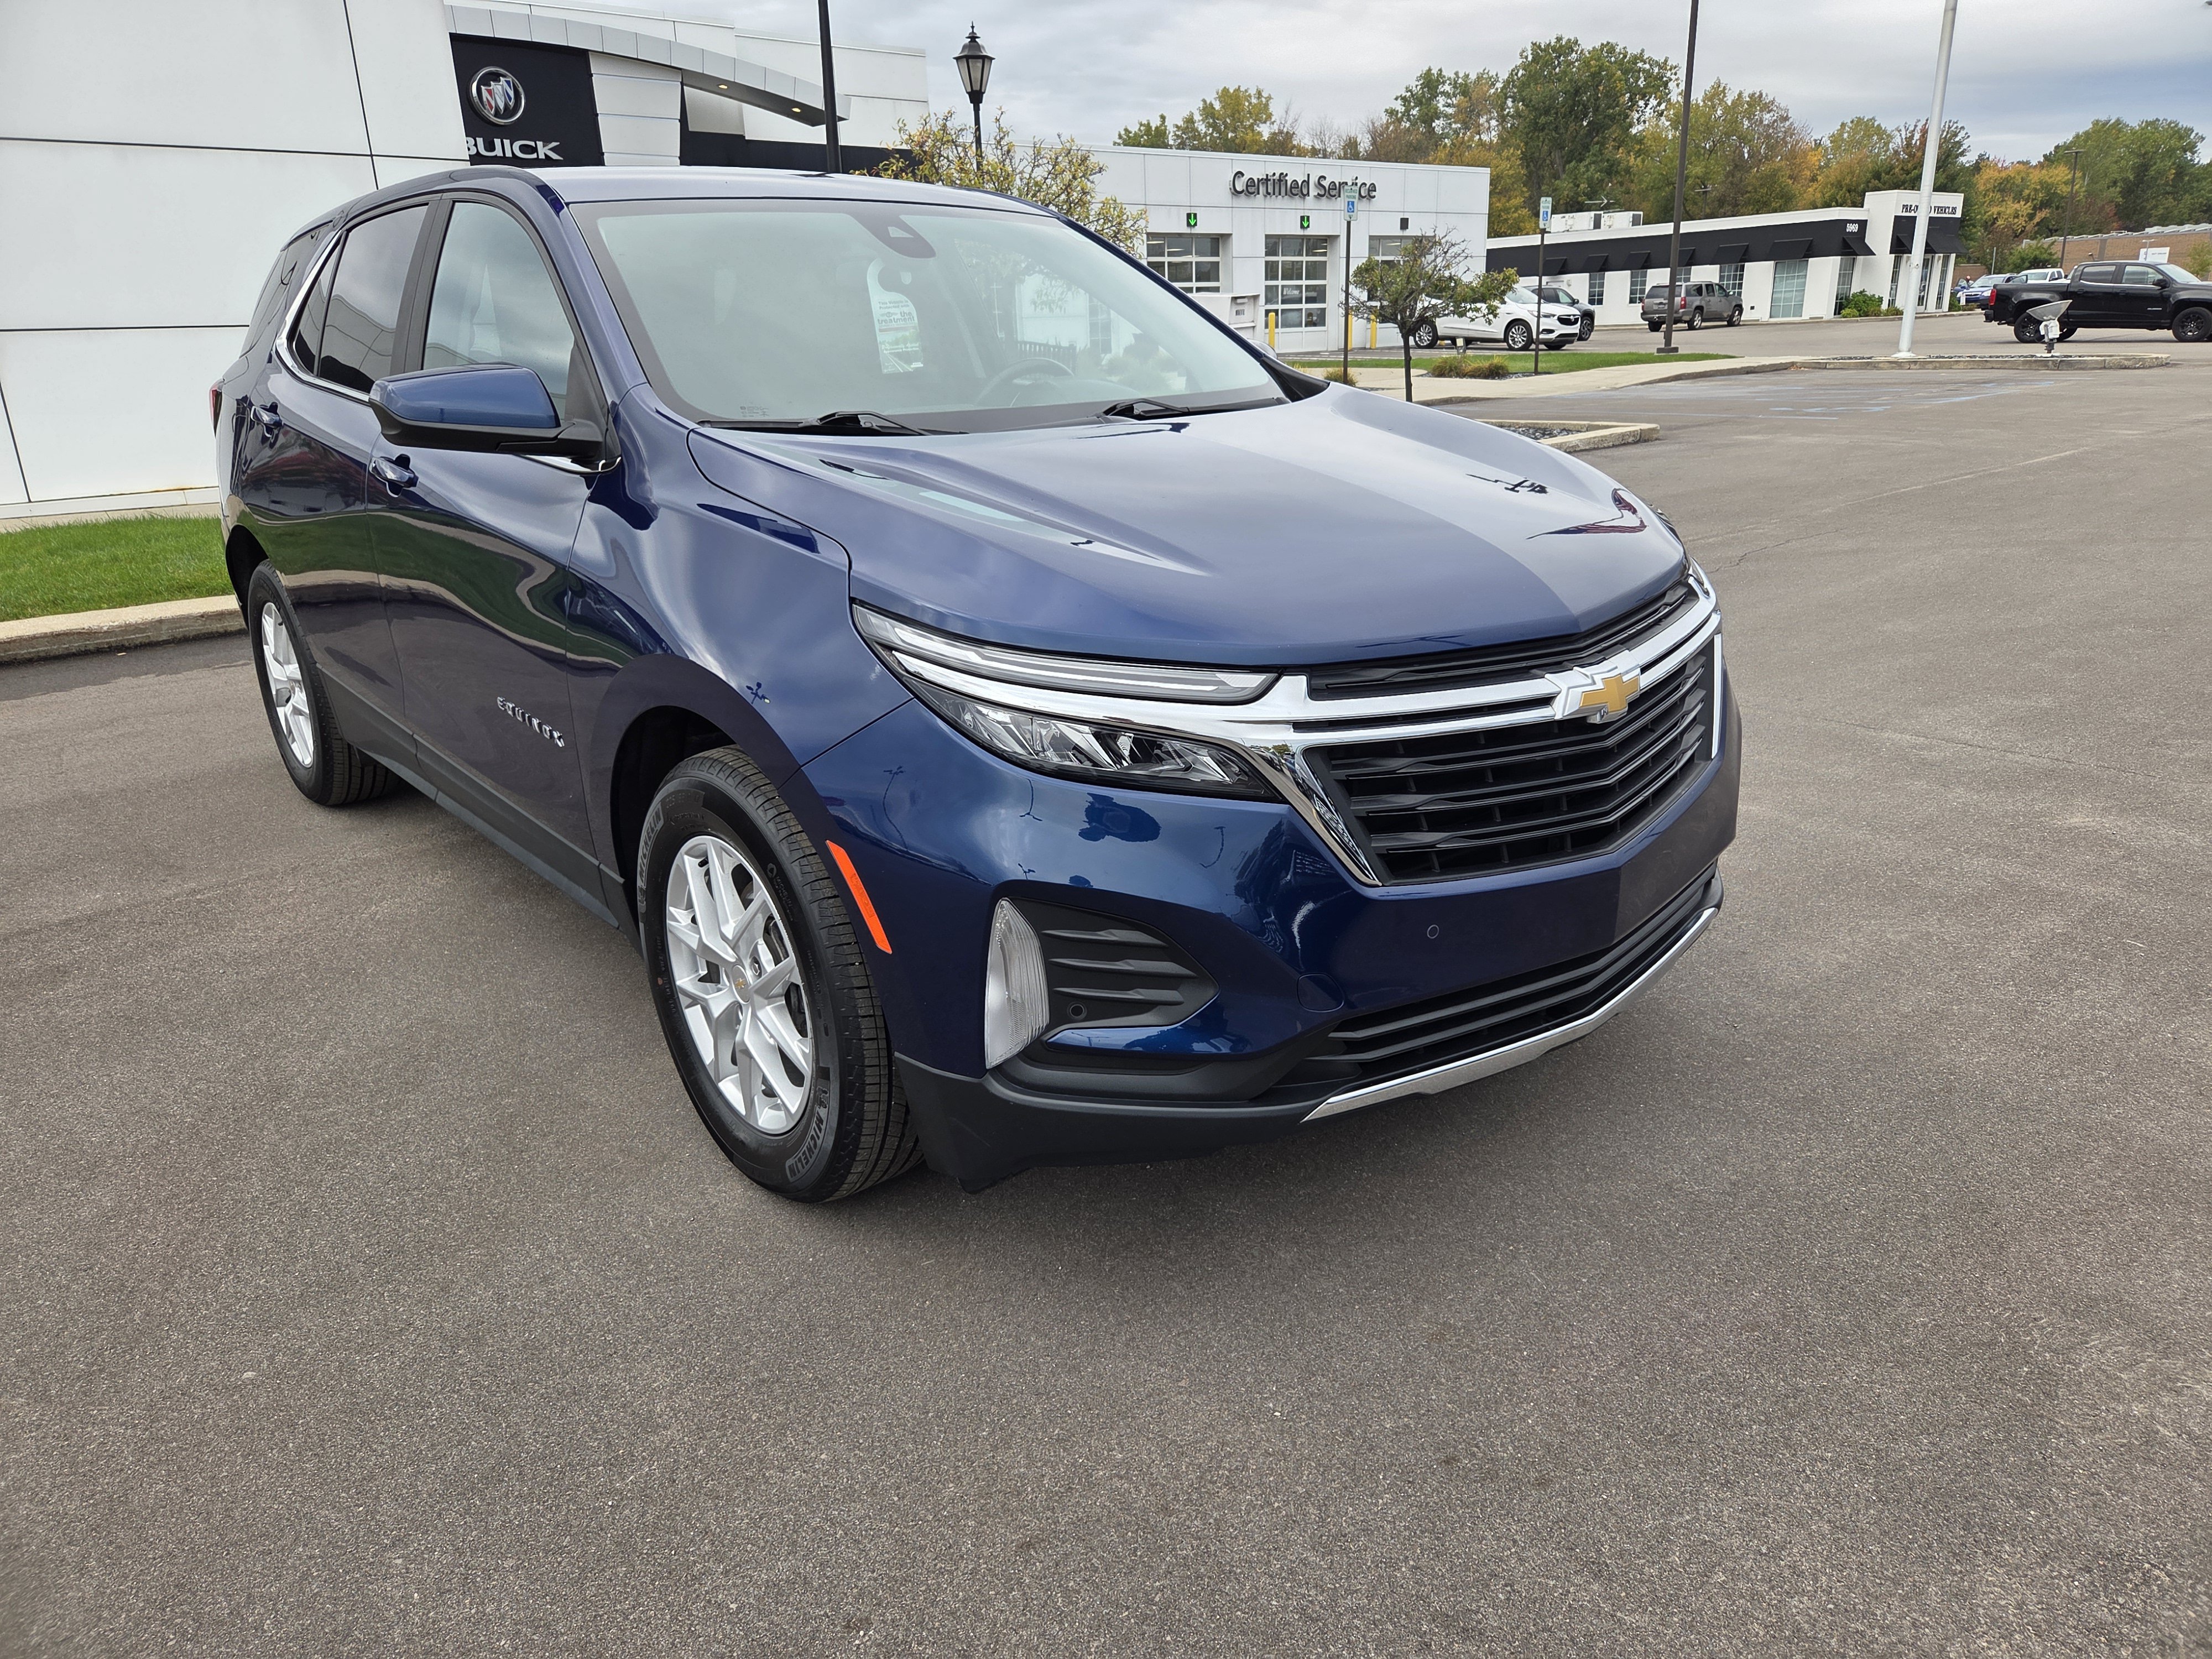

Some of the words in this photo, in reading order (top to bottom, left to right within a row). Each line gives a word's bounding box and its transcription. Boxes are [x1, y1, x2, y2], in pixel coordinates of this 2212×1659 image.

[465, 137, 564, 160] BUICK
[1232, 170, 1310, 197] Certified
[1316, 175, 1377, 199] Serce
[1933, 206, 1957, 215] VEHICLES
[1846, 223, 1859, 232] 5969
[877, 315, 915, 324] treatment
[497, 696, 565, 747] EQUINOX
[639, 807, 661, 884] MICHELIN
[787, 1110, 824, 1178] MICHELIN
